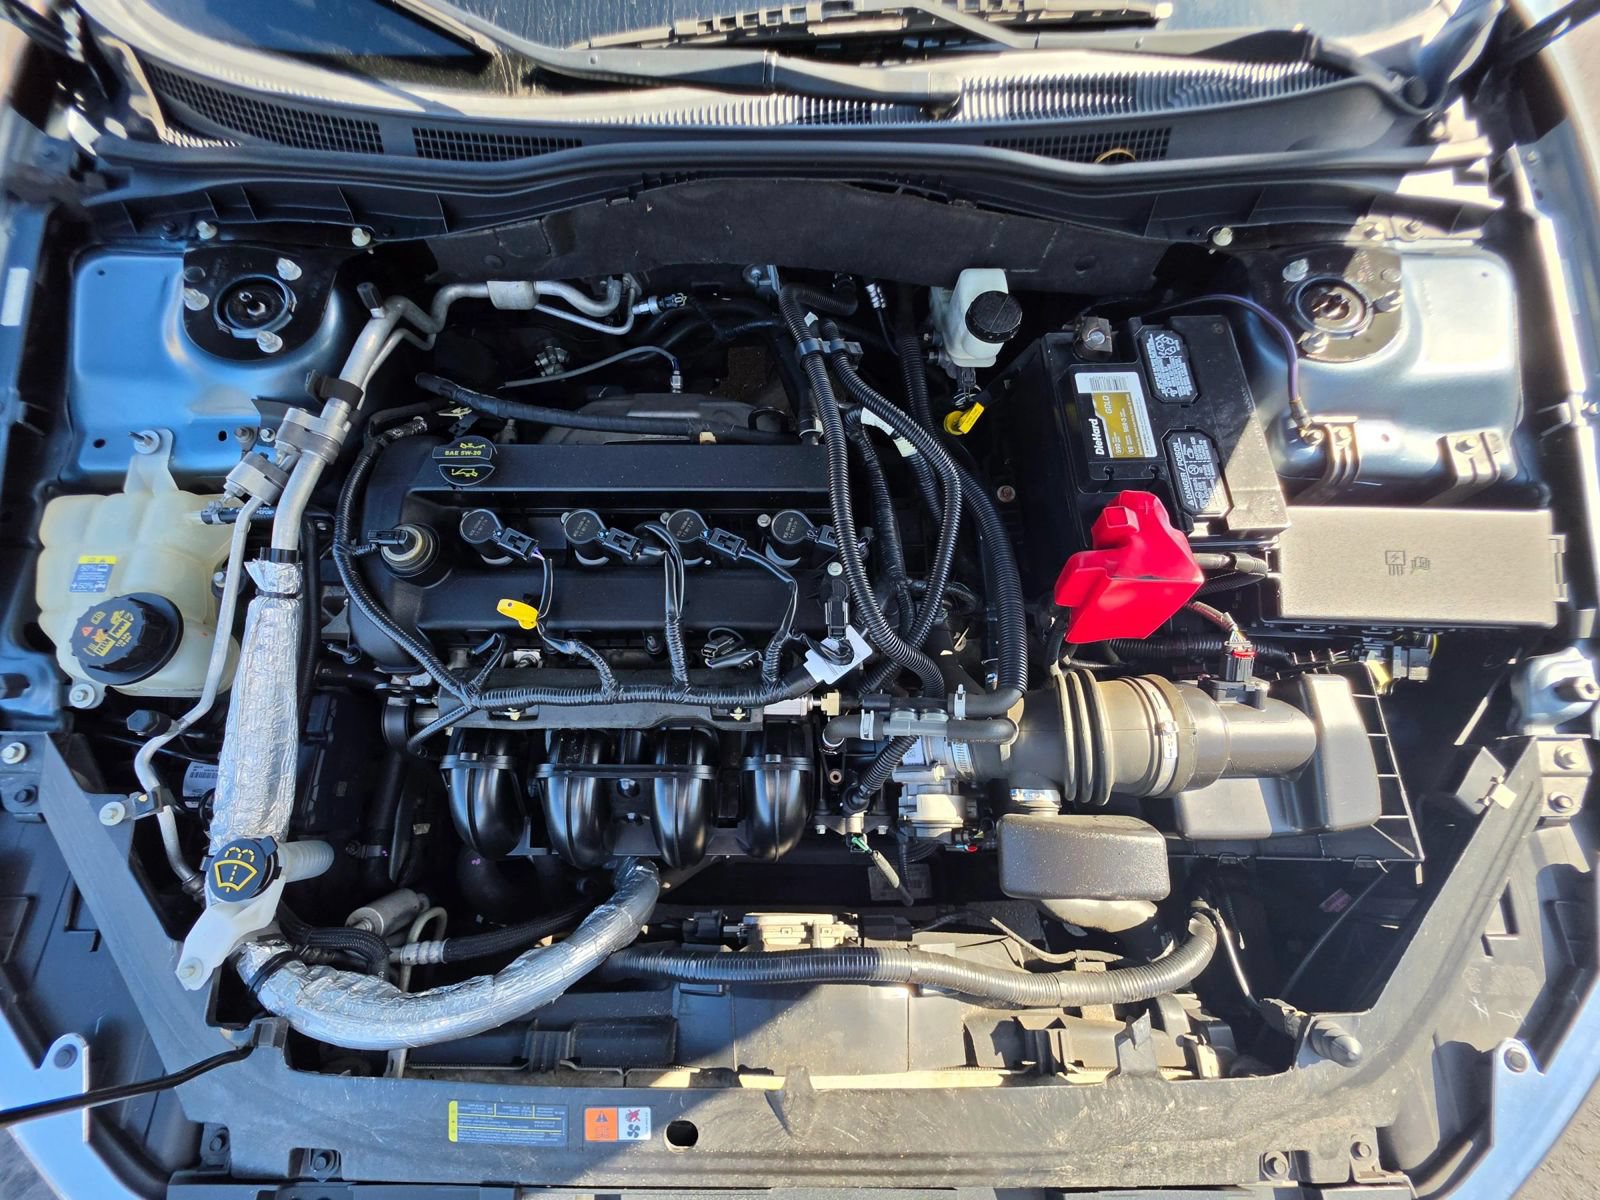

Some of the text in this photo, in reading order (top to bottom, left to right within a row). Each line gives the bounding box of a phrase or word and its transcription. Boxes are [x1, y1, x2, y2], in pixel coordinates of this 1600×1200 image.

[1089, 418, 1105, 455] DieHard
[1172, 442, 1184, 466] POISON
[1180, 472, 1193, 499] DANGER
